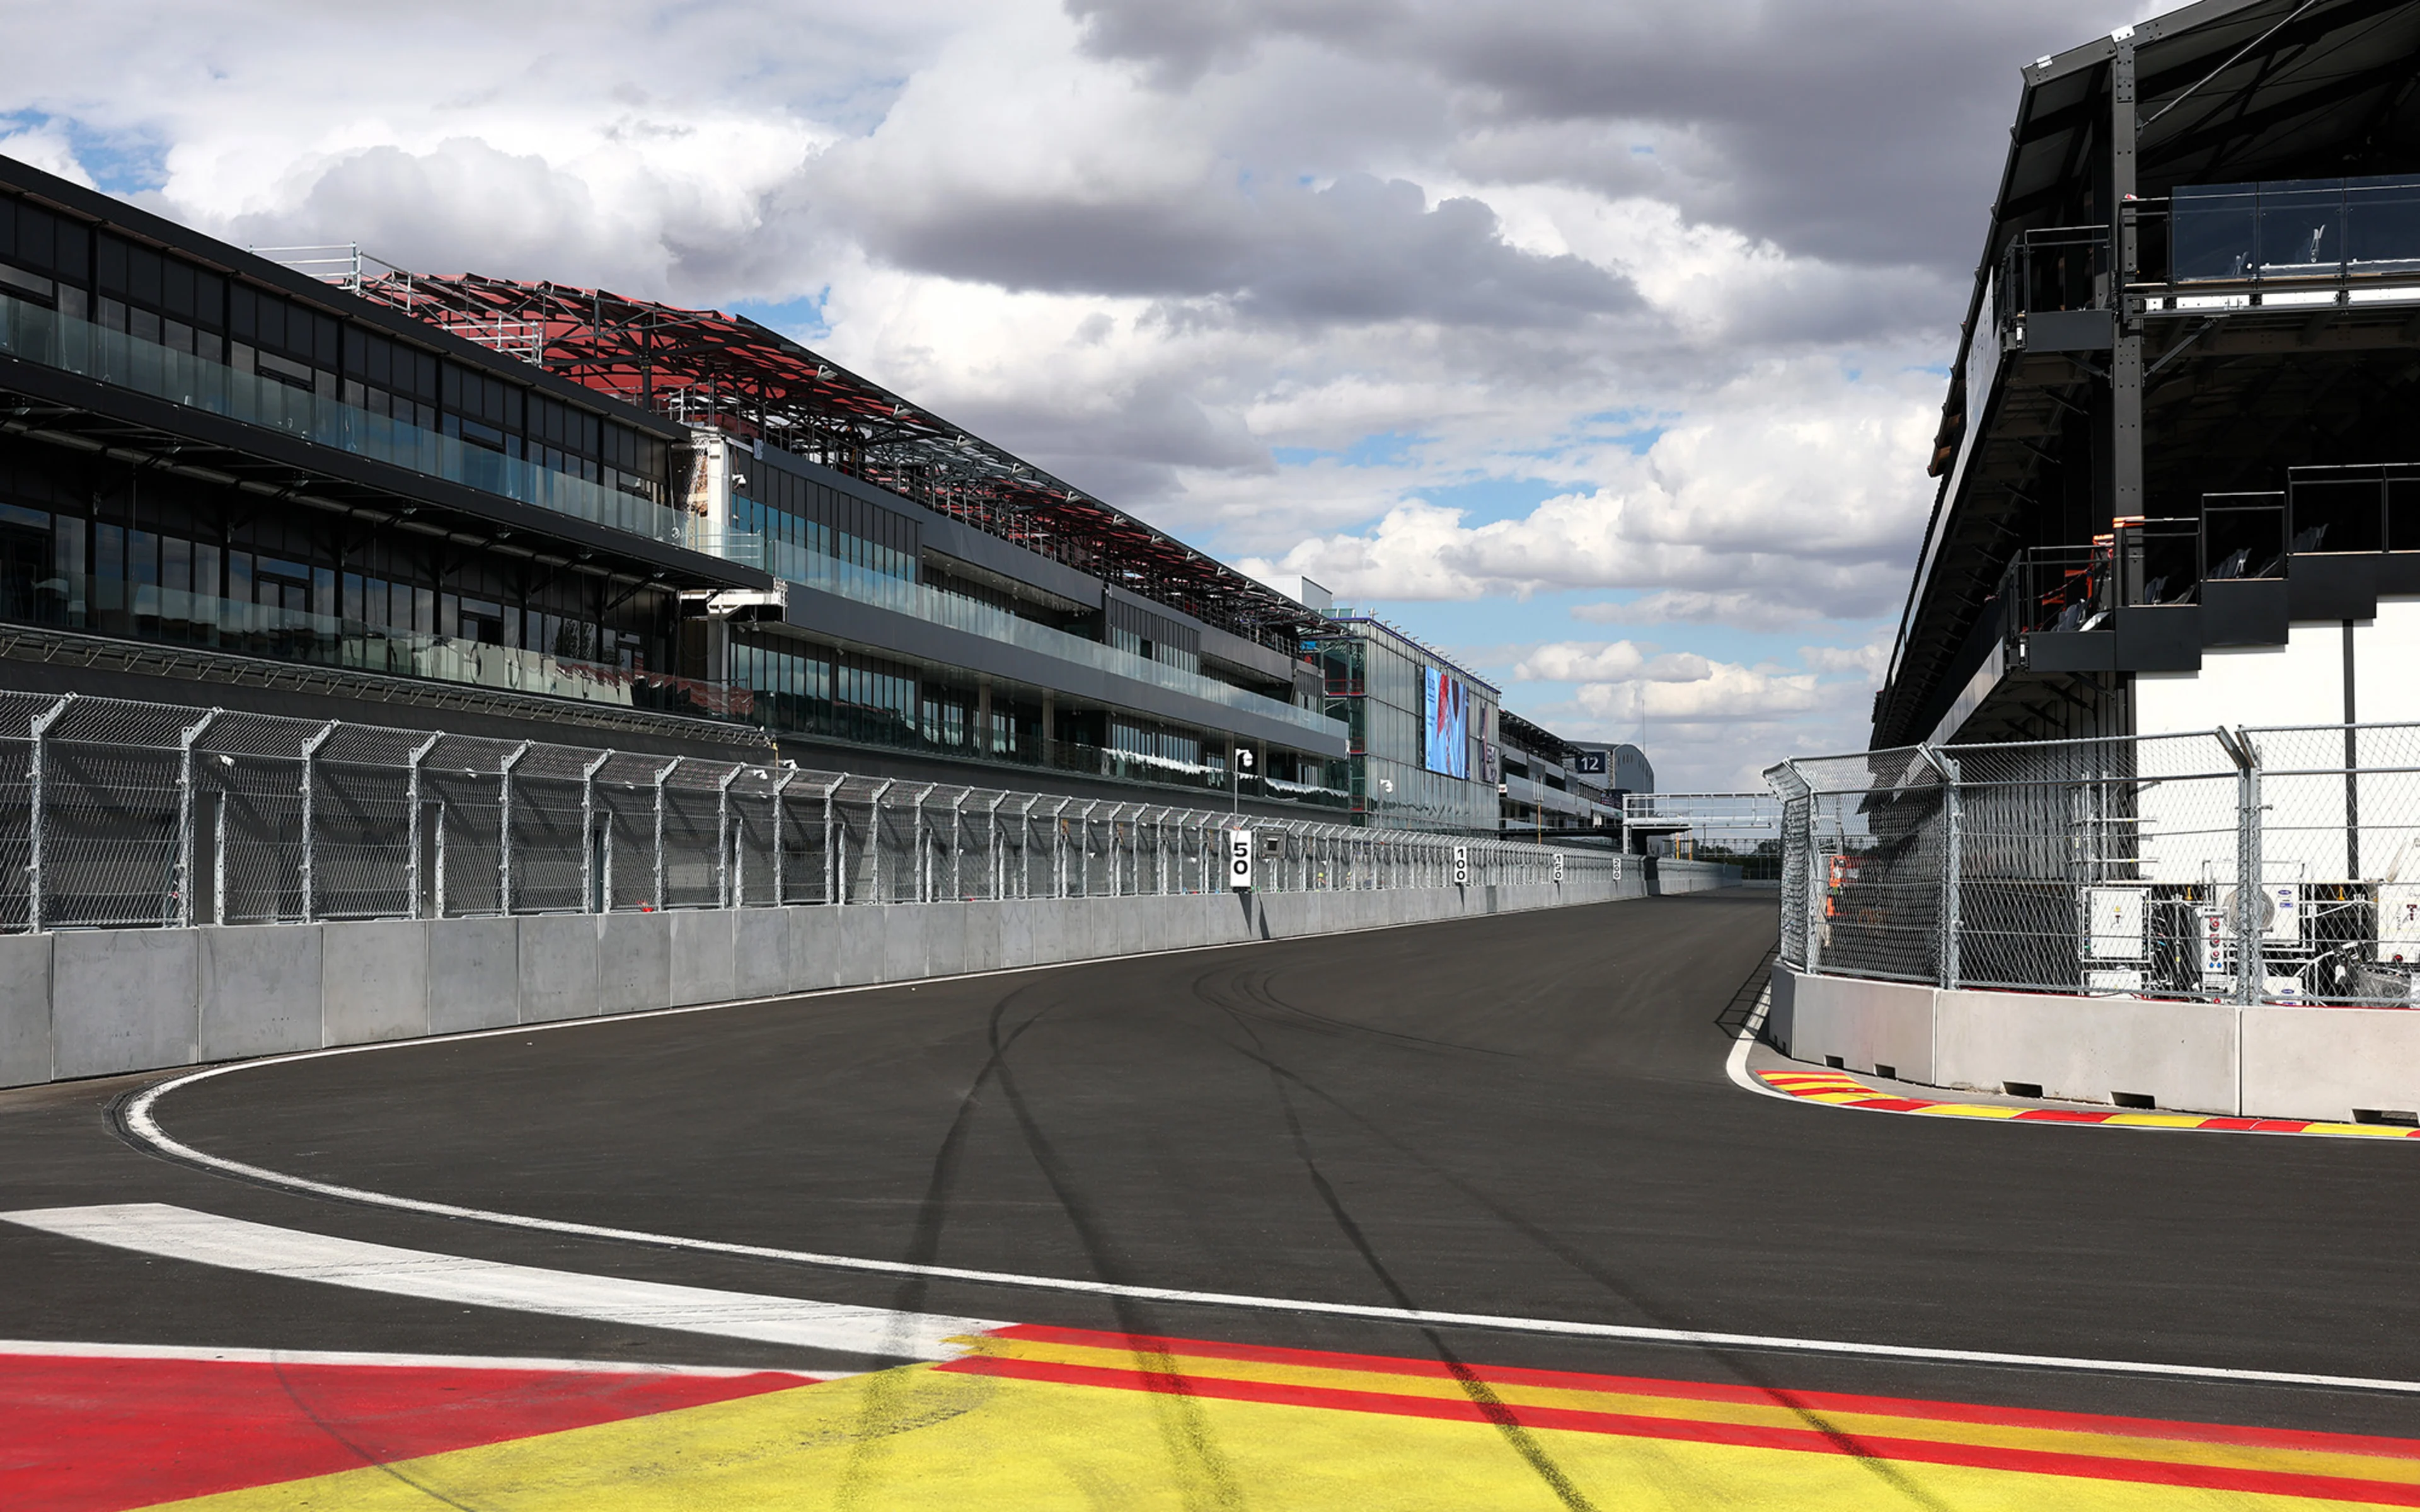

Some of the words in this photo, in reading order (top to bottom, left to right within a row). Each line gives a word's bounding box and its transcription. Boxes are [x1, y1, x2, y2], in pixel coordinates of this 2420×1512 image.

[1581, 756, 1599, 770] 12
[1233, 842, 1248, 874] 50
[1456, 849, 1465, 879] 100
